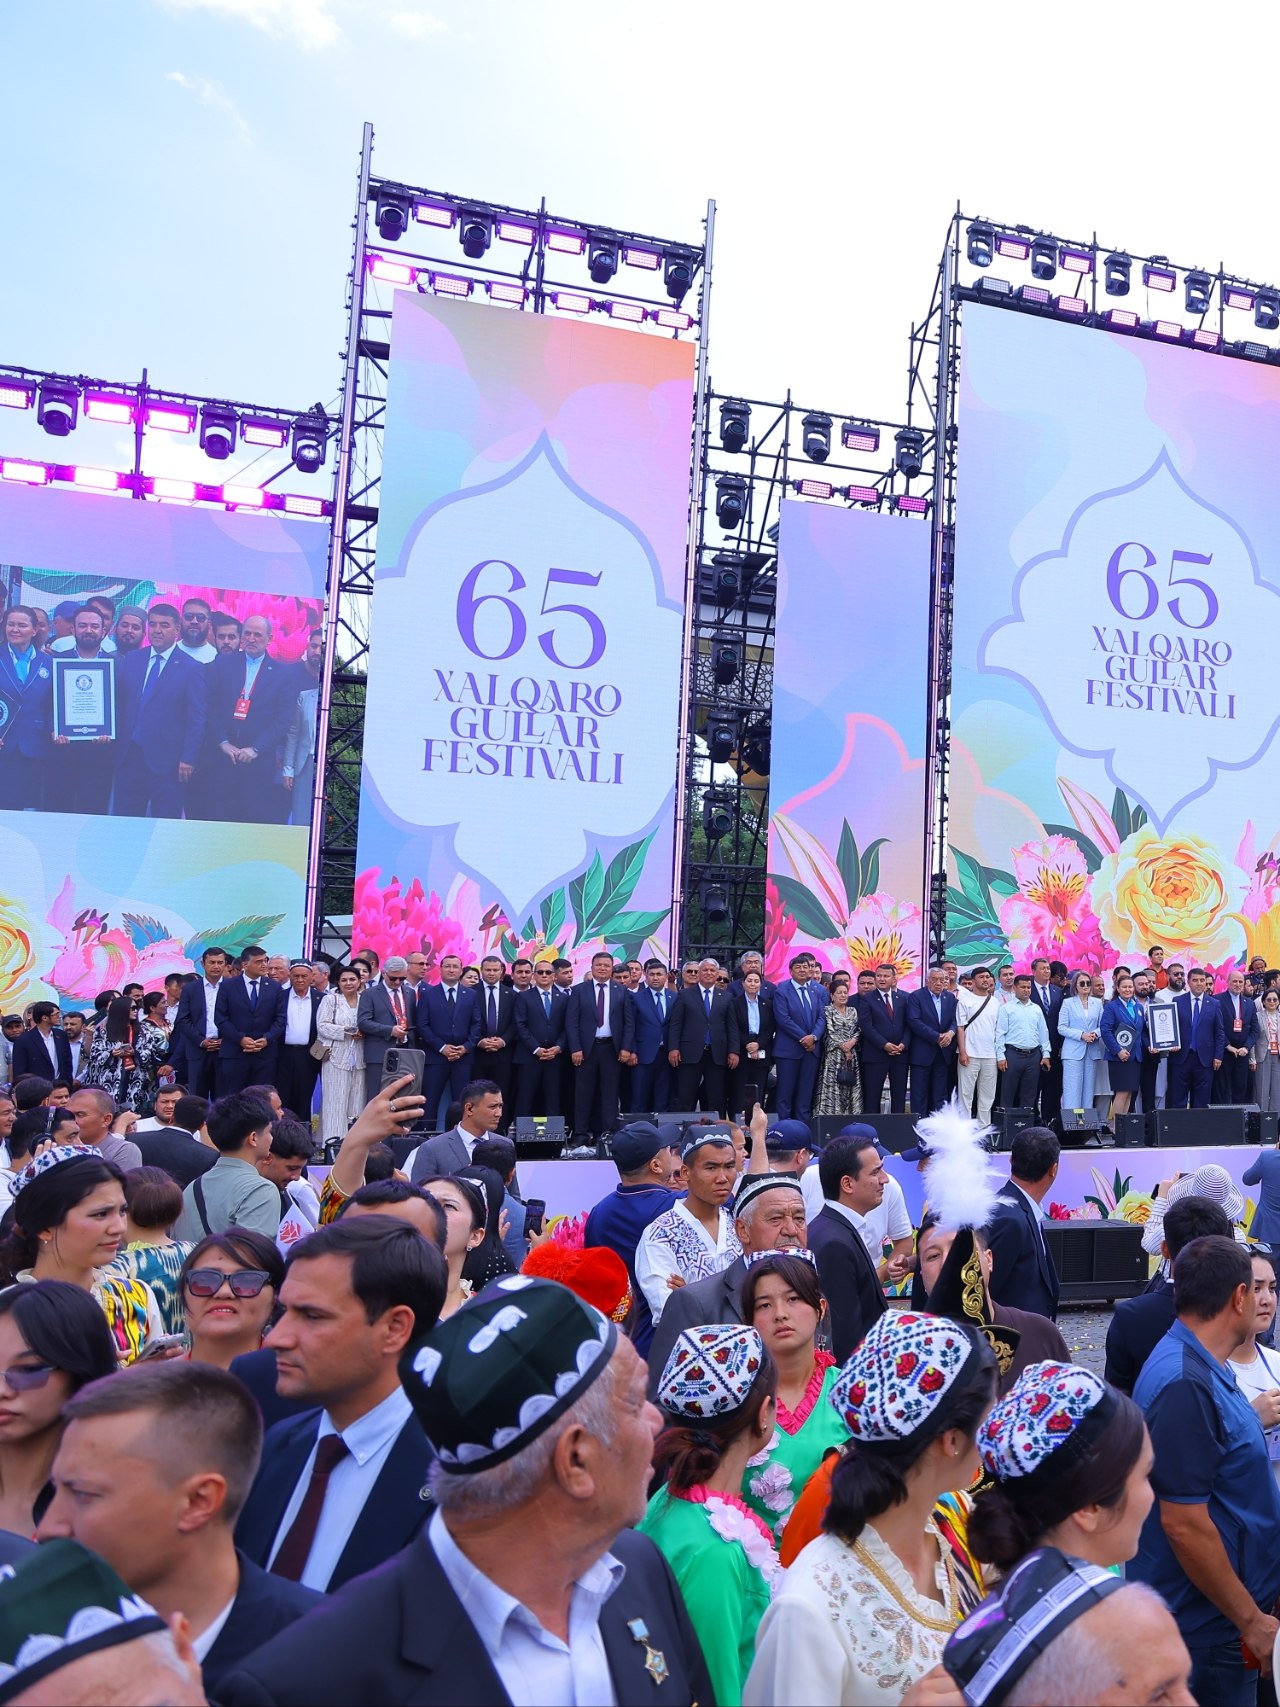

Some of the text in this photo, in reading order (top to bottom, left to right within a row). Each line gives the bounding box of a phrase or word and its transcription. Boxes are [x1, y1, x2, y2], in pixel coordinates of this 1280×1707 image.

[1106, 541, 1219, 629] 65
[456, 559, 607, 670] 65
[1092, 625, 1232, 667] XALQARO
[433, 668, 622, 718] XALQARO
[1085, 679, 1236, 719] FESTIVALI
[421, 738, 624, 784] FESTIVALI
